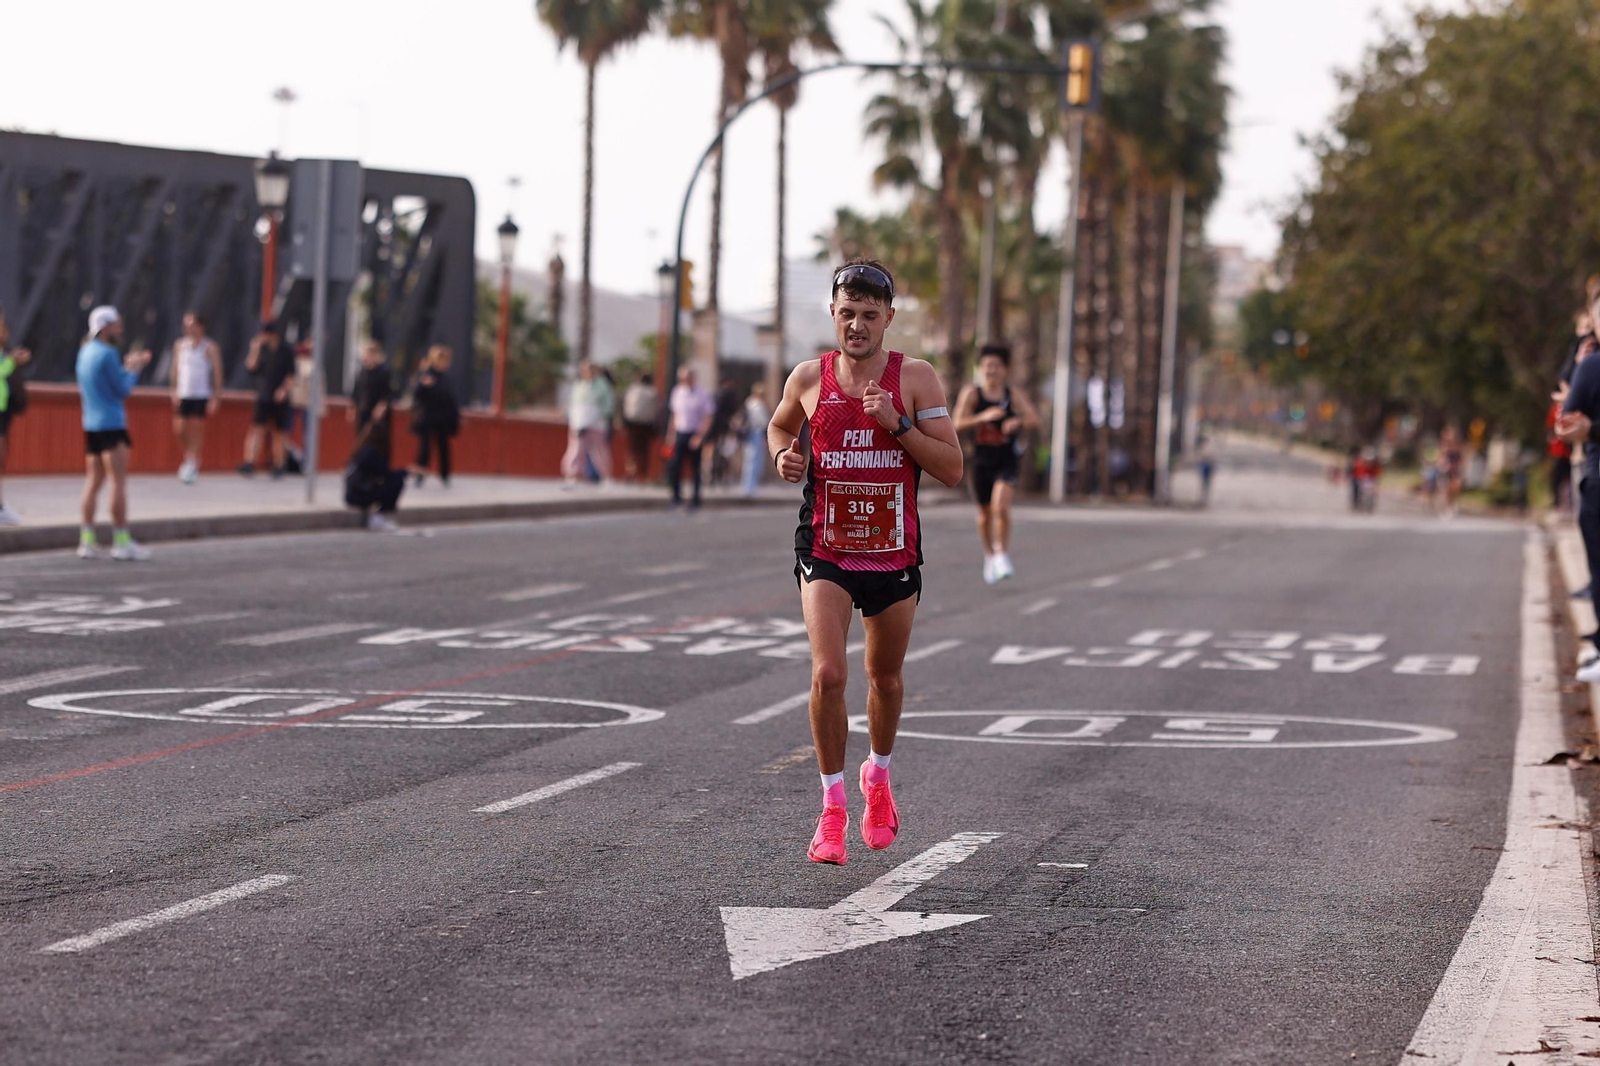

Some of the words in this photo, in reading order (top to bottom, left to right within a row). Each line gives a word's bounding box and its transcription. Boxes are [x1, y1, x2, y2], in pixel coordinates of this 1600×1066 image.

[843, 430, 874, 447] PEAK
[820, 450, 903, 468] PERFORMANCE
[844, 485, 891, 495] GENERALI
[848, 501, 875, 514] 316
[178, 693, 515, 722] 50
[978, 715, 1286, 742] 50
